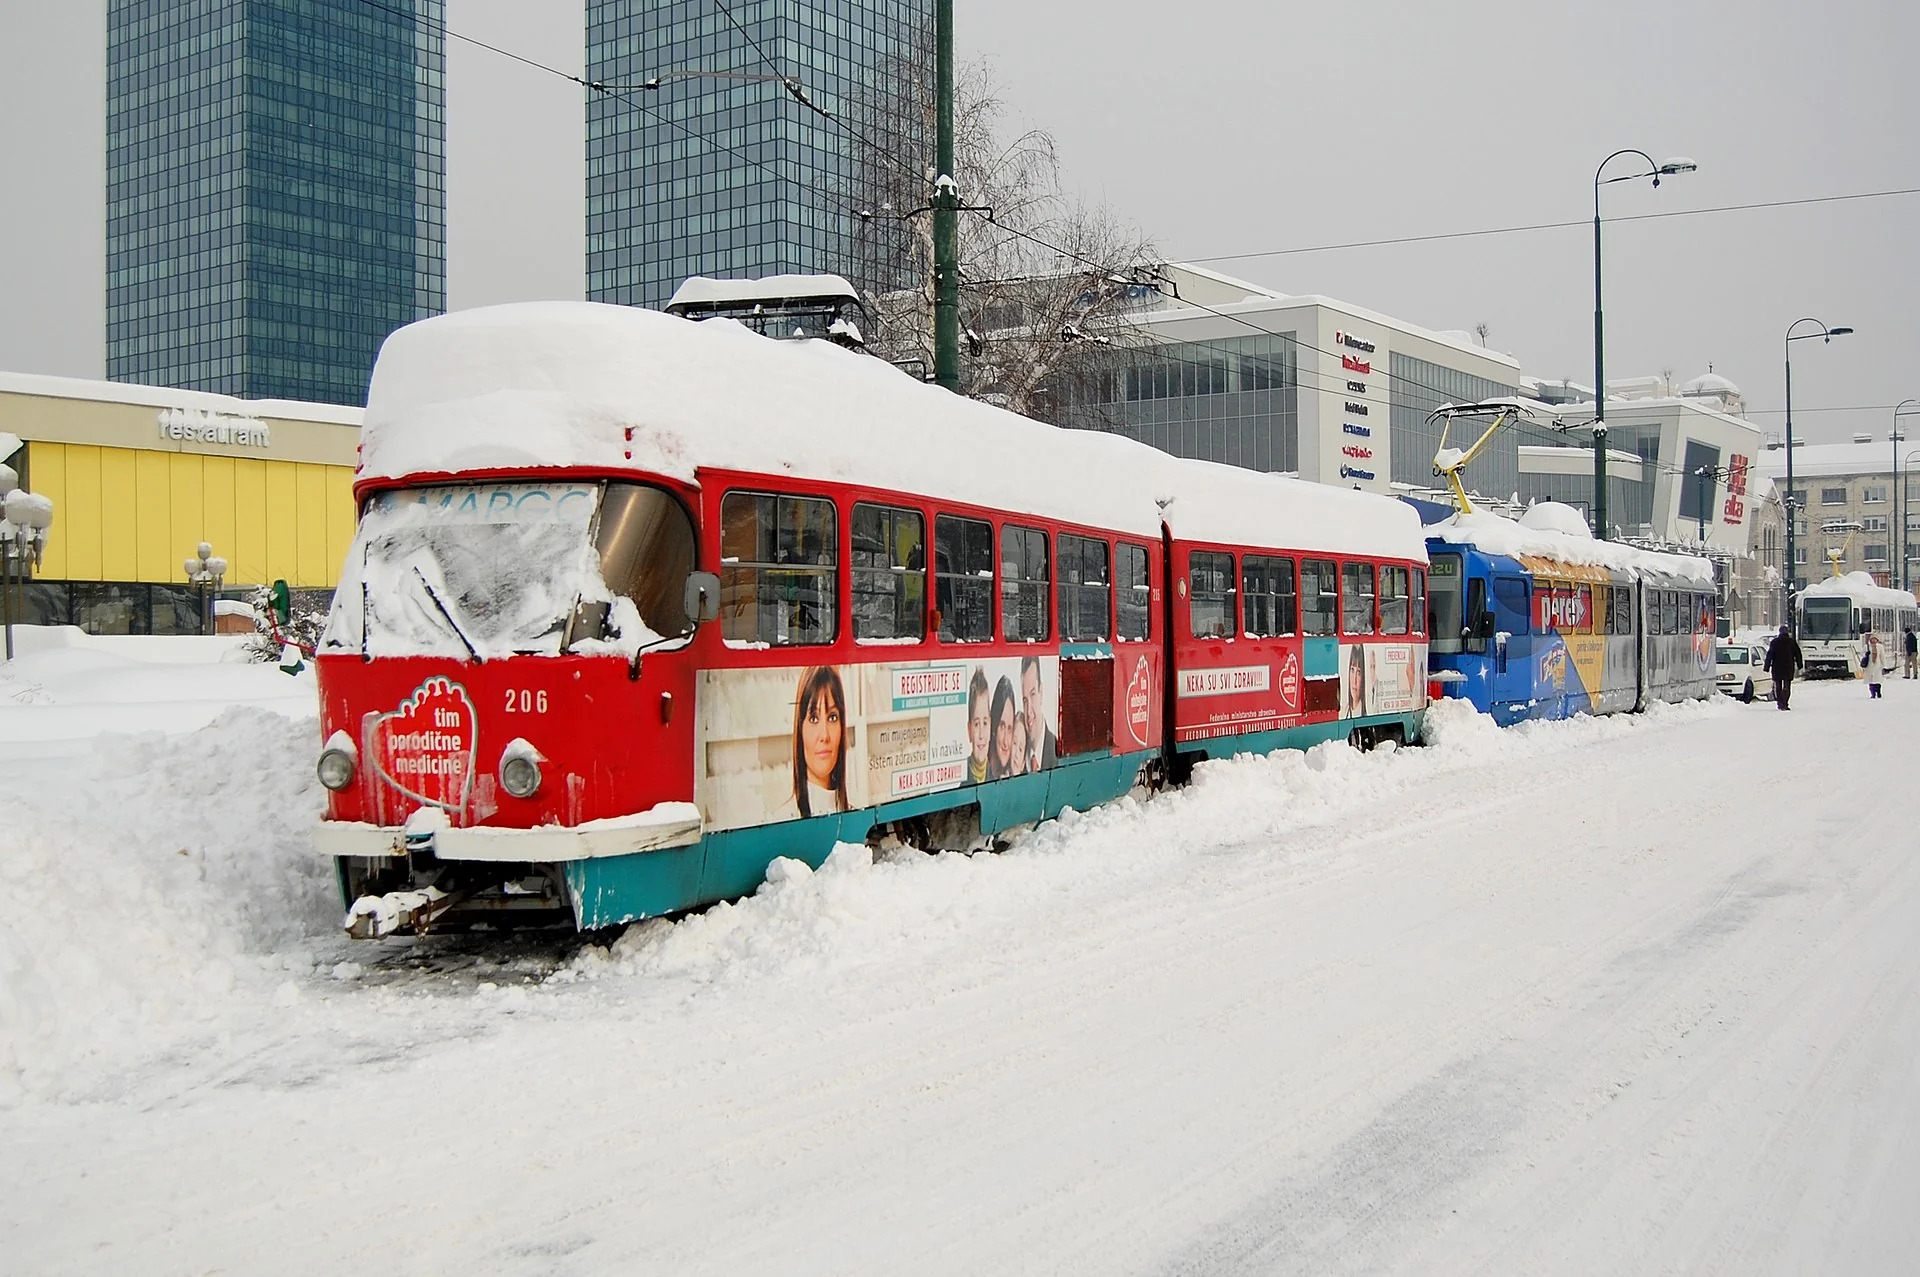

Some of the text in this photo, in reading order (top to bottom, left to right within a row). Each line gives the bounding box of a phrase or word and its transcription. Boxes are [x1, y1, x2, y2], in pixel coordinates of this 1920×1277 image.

[159, 419, 270, 448] restaurant
[901, 672, 960, 695] REGISTRUJTE SE
[1186, 673, 1205, 692] NEKA
[1207, 673, 1217, 691] SU
[1220, 673, 1231, 690] SVI
[505, 688, 549, 714] 206
[434, 707, 461, 728] tim
[1209, 712, 1230, 722] Federalno
[1231, 710, 1257, 720] ministarstvo
[388, 730, 462, 756] porodične
[880, 726, 928, 746] mi mijenjamo
[931, 739, 964, 759] vi navike
[395, 754, 462, 775] medicine
[869, 749, 927, 771] sistem zdravstva
[898, 774, 913, 790] NEKA
[915, 771, 923, 787] SU
[925, 769, 935, 785] SVI
